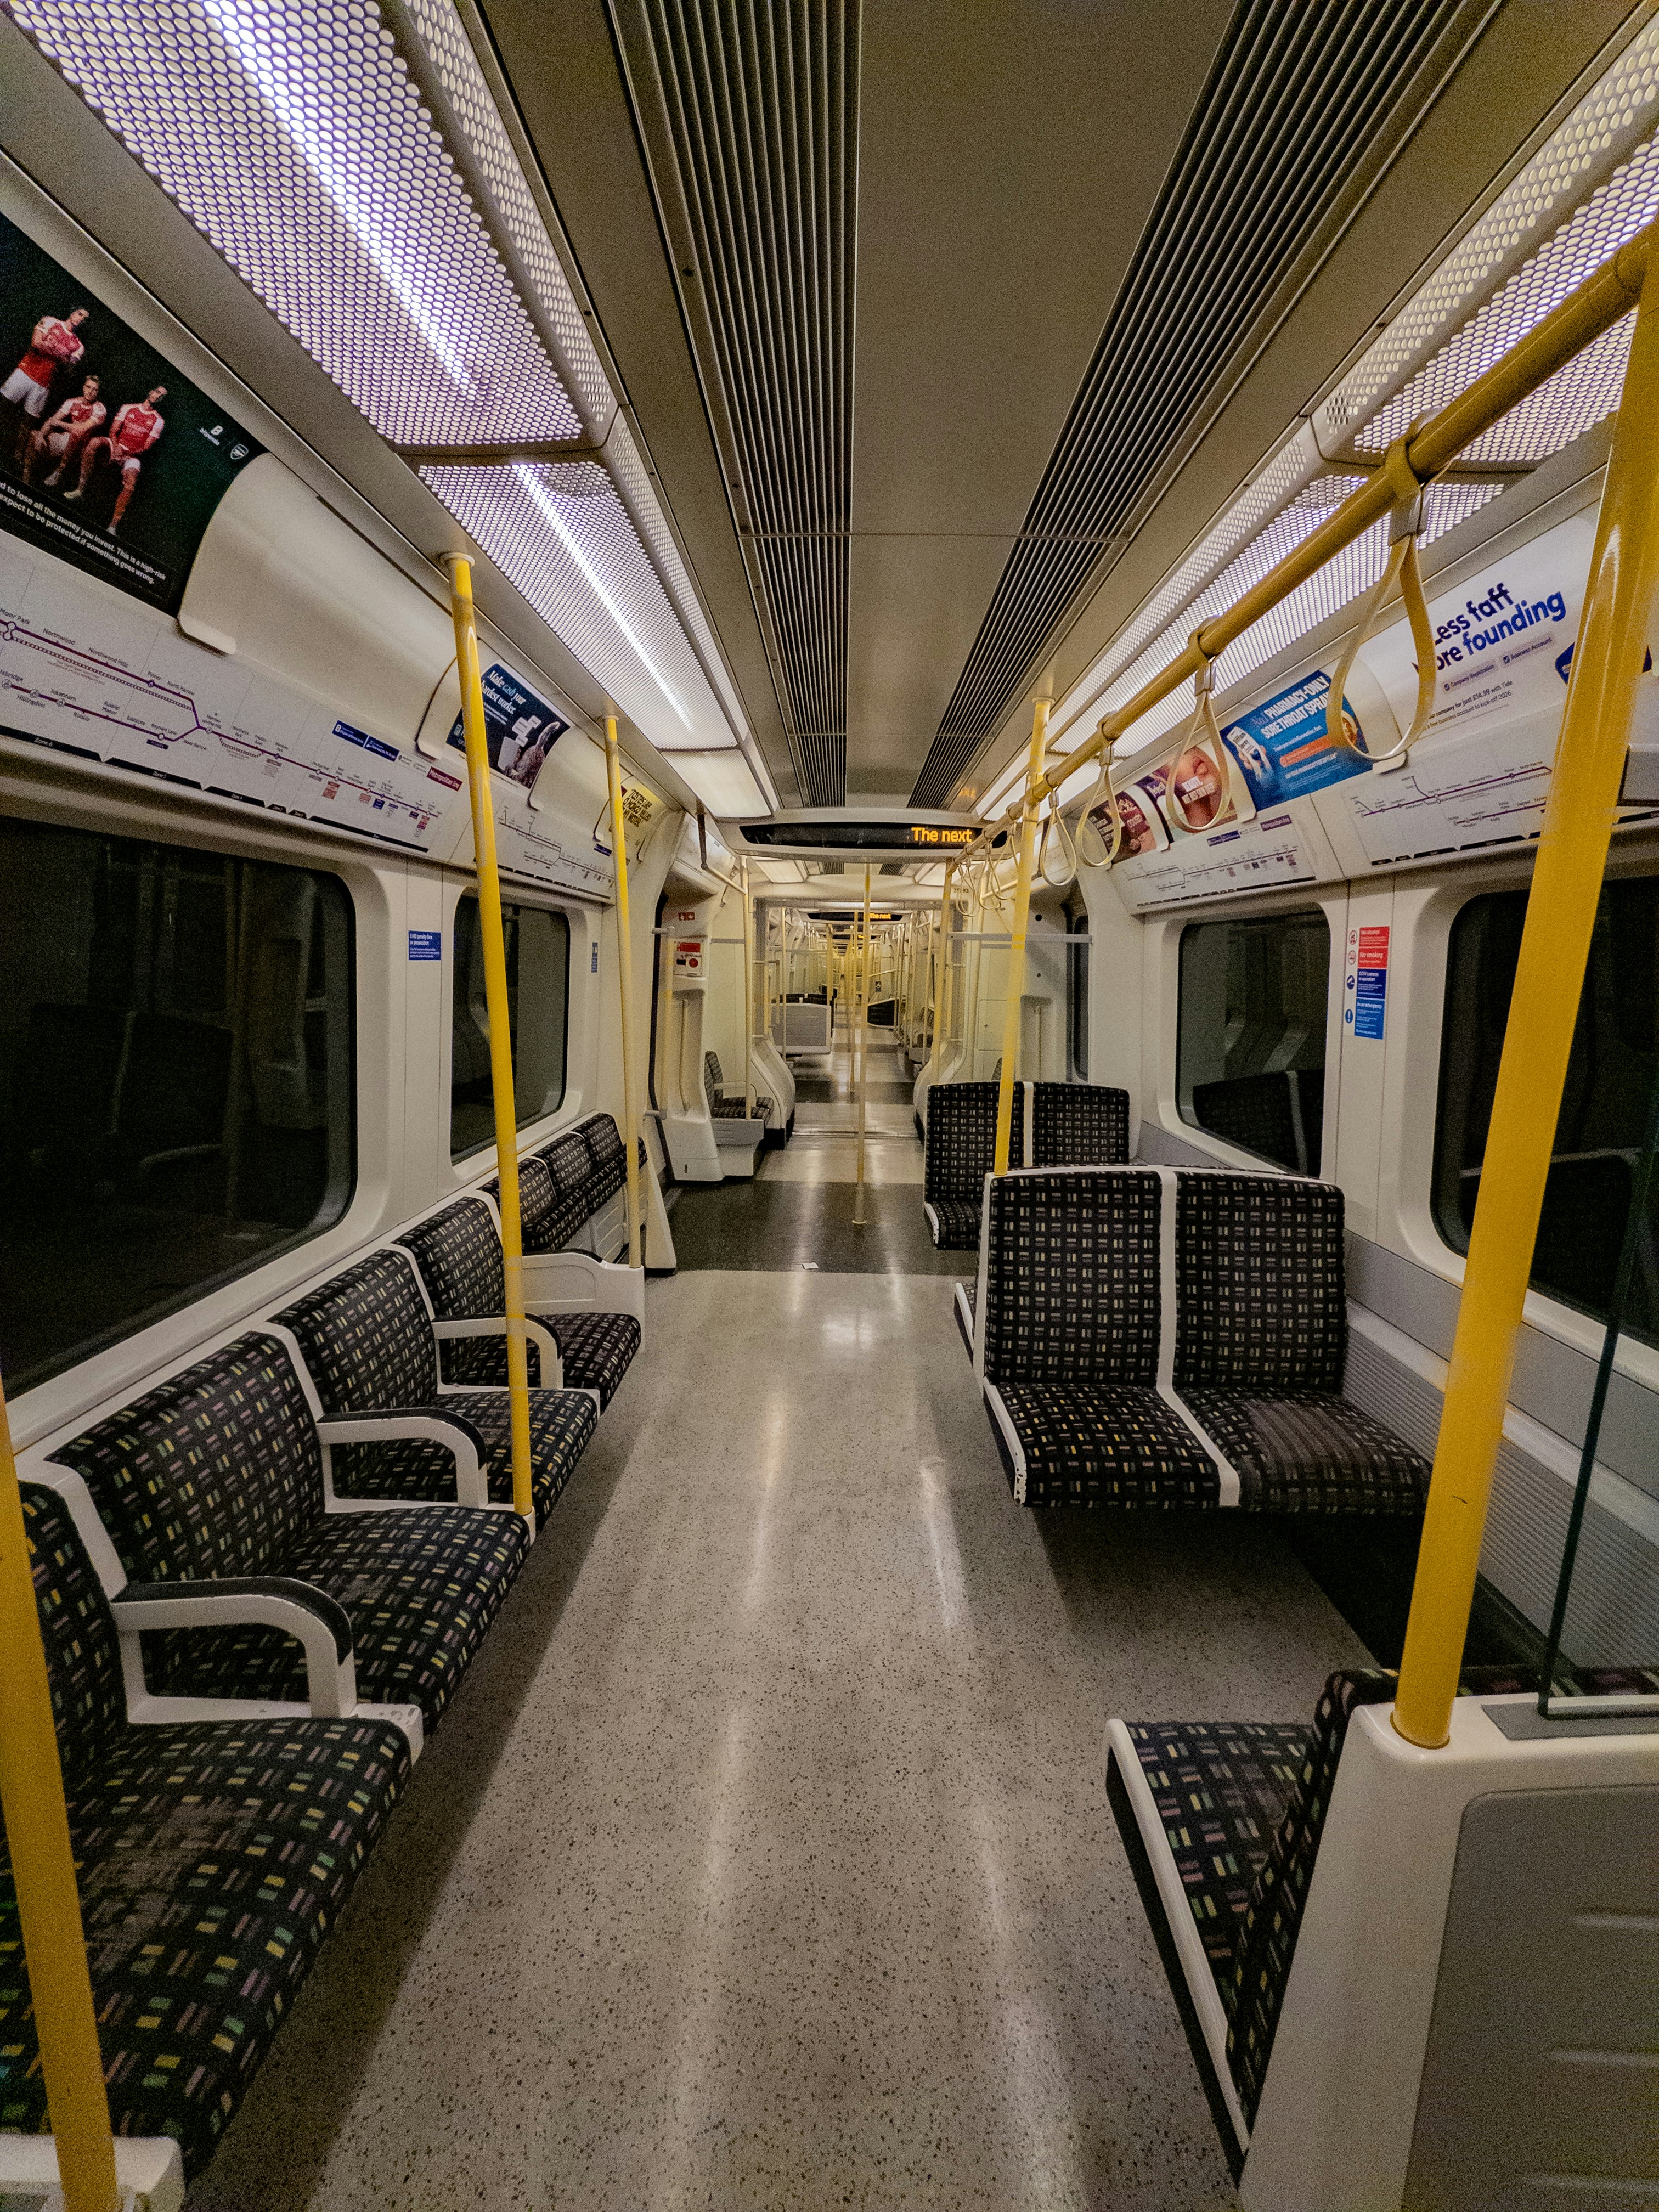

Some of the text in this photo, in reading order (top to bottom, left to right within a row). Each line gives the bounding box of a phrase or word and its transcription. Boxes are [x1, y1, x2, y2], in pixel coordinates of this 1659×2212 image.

[7, 485, 16, 495] to
[17, 489, 33, 505] lose
[33, 501, 44, 511] all
[44, 507, 56, 518] the
[57, 514, 81, 533] money
[81, 528, 94, 540] you
[94, 535, 115, 552] invest.
[117, 548, 129, 560] This
[129, 555, 136, 563] is
[140, 562, 166, 580] high-risk
[26, 507, 35, 517] to
[35, 512, 45, 523] be
[46, 518, 81, 542] protected
[81, 538, 87, 546] if
[87, 543, 120, 566] something
[120, 560, 135, 573] goes
[136, 568, 155, 584] wrong.
[0, 608, 31, 625] Moor Park
[1465, 582, 1515, 623] faff
[43, 628, 76, 646] Northwood
[1462, 590, 1566, 656] founding
[89, 647, 117, 664] Northwood
[1530, 637, 1553, 652] Account
[487, 670, 527, 705] Make cash your
[1263, 675, 1331, 720] PHARMACY-ONLY
[1462, 696, 1473, 708] just
[1472, 688, 1491, 702] £14.99
[1491, 685, 1502, 695] with
[1501, 680, 1514, 690] Tide
[498, 696, 517, 715] worker.
[1261, 722, 1284, 740] SORE
[1279, 706, 1309, 730] THROAT
[1304, 691, 1329, 716] SPRA
[1456, 706, 1475, 719] account
[1498, 690, 1513, 702] 2026
[428, 769, 460, 789] Metropolitan line
[911, 827, 973, 843] The next
